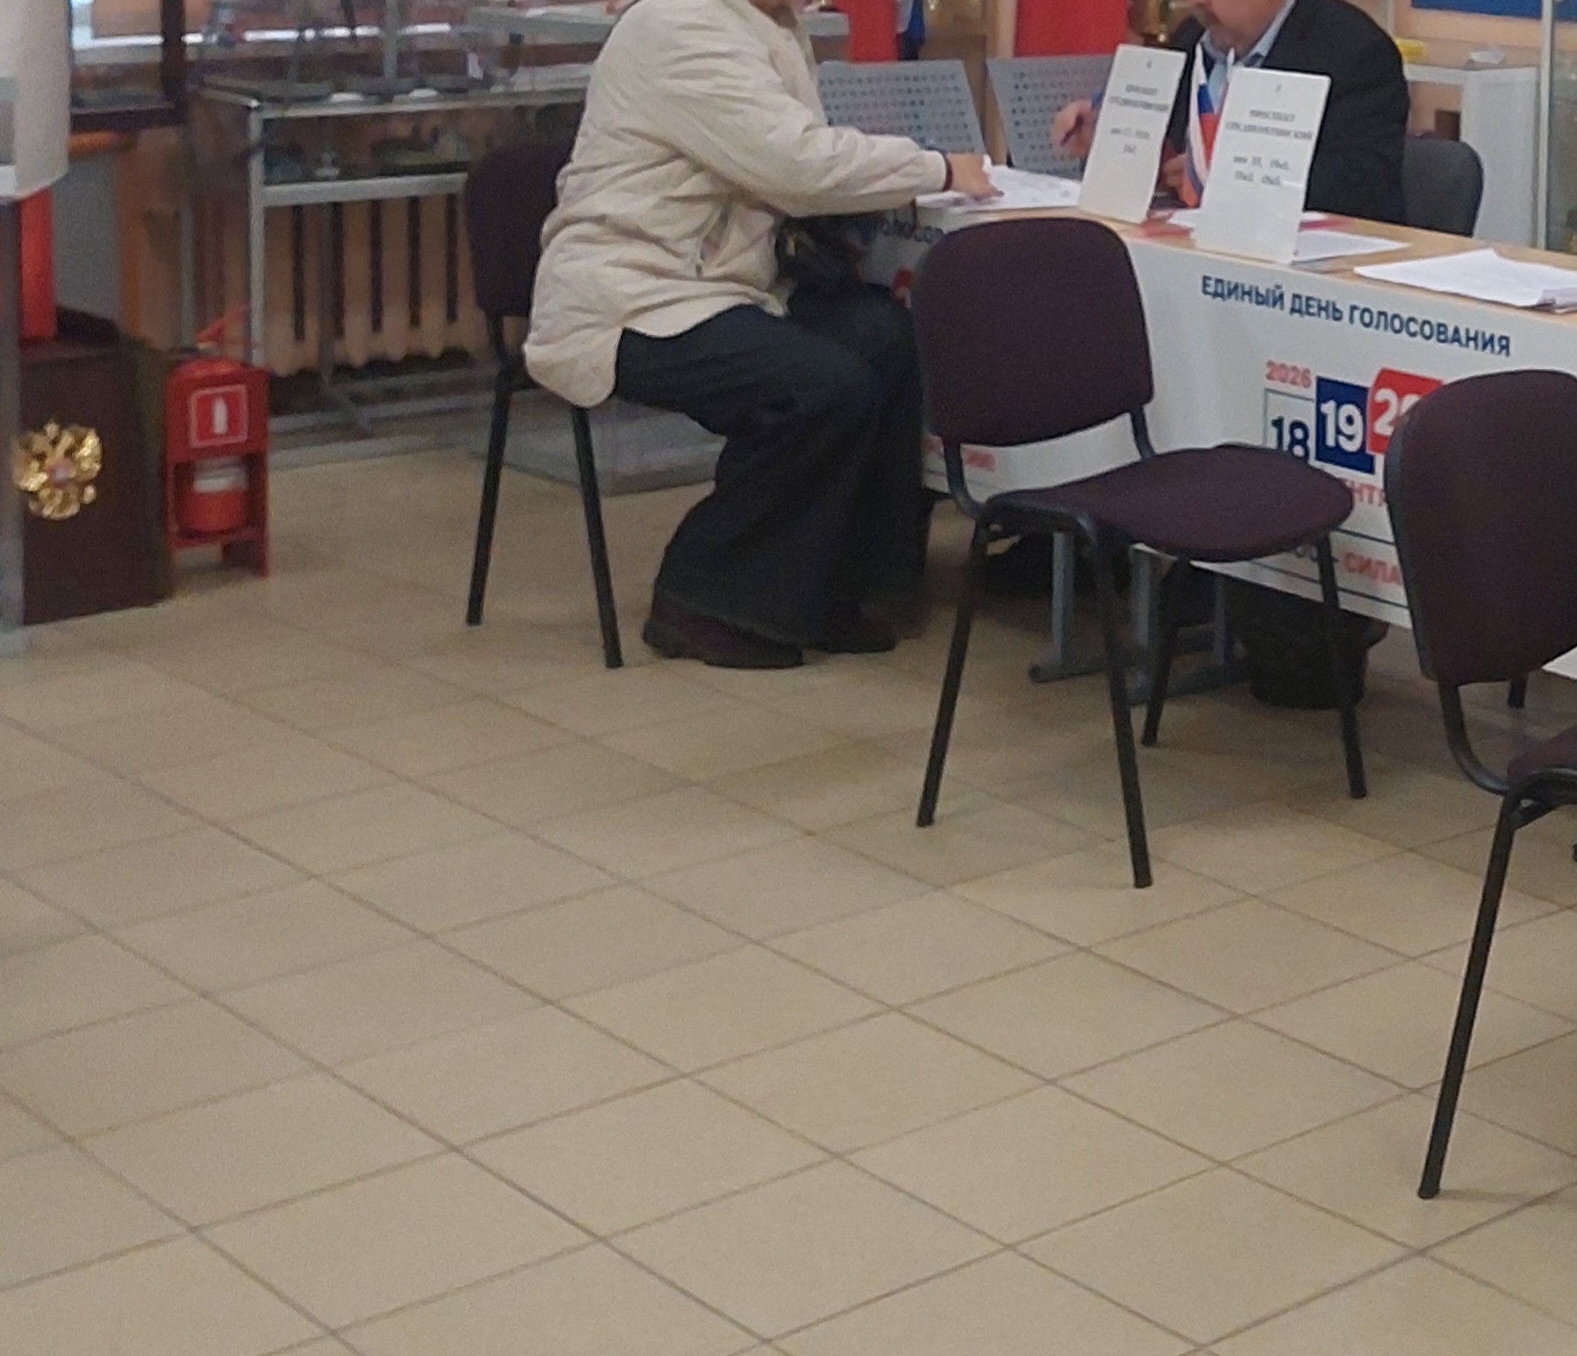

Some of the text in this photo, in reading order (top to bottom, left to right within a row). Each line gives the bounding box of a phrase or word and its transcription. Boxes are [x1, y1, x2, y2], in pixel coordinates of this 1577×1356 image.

[1201, 274, 1511, 358] ЕДИНЫЙ ДЕНЬ ГОЛОСОВАНИЯ
[1265, 359, 1312, 388] 2026
[1320, 399, 1364, 453] 19
[1373, 388, 1420, 437] 2
[1271, 415, 1310, 461] 18
